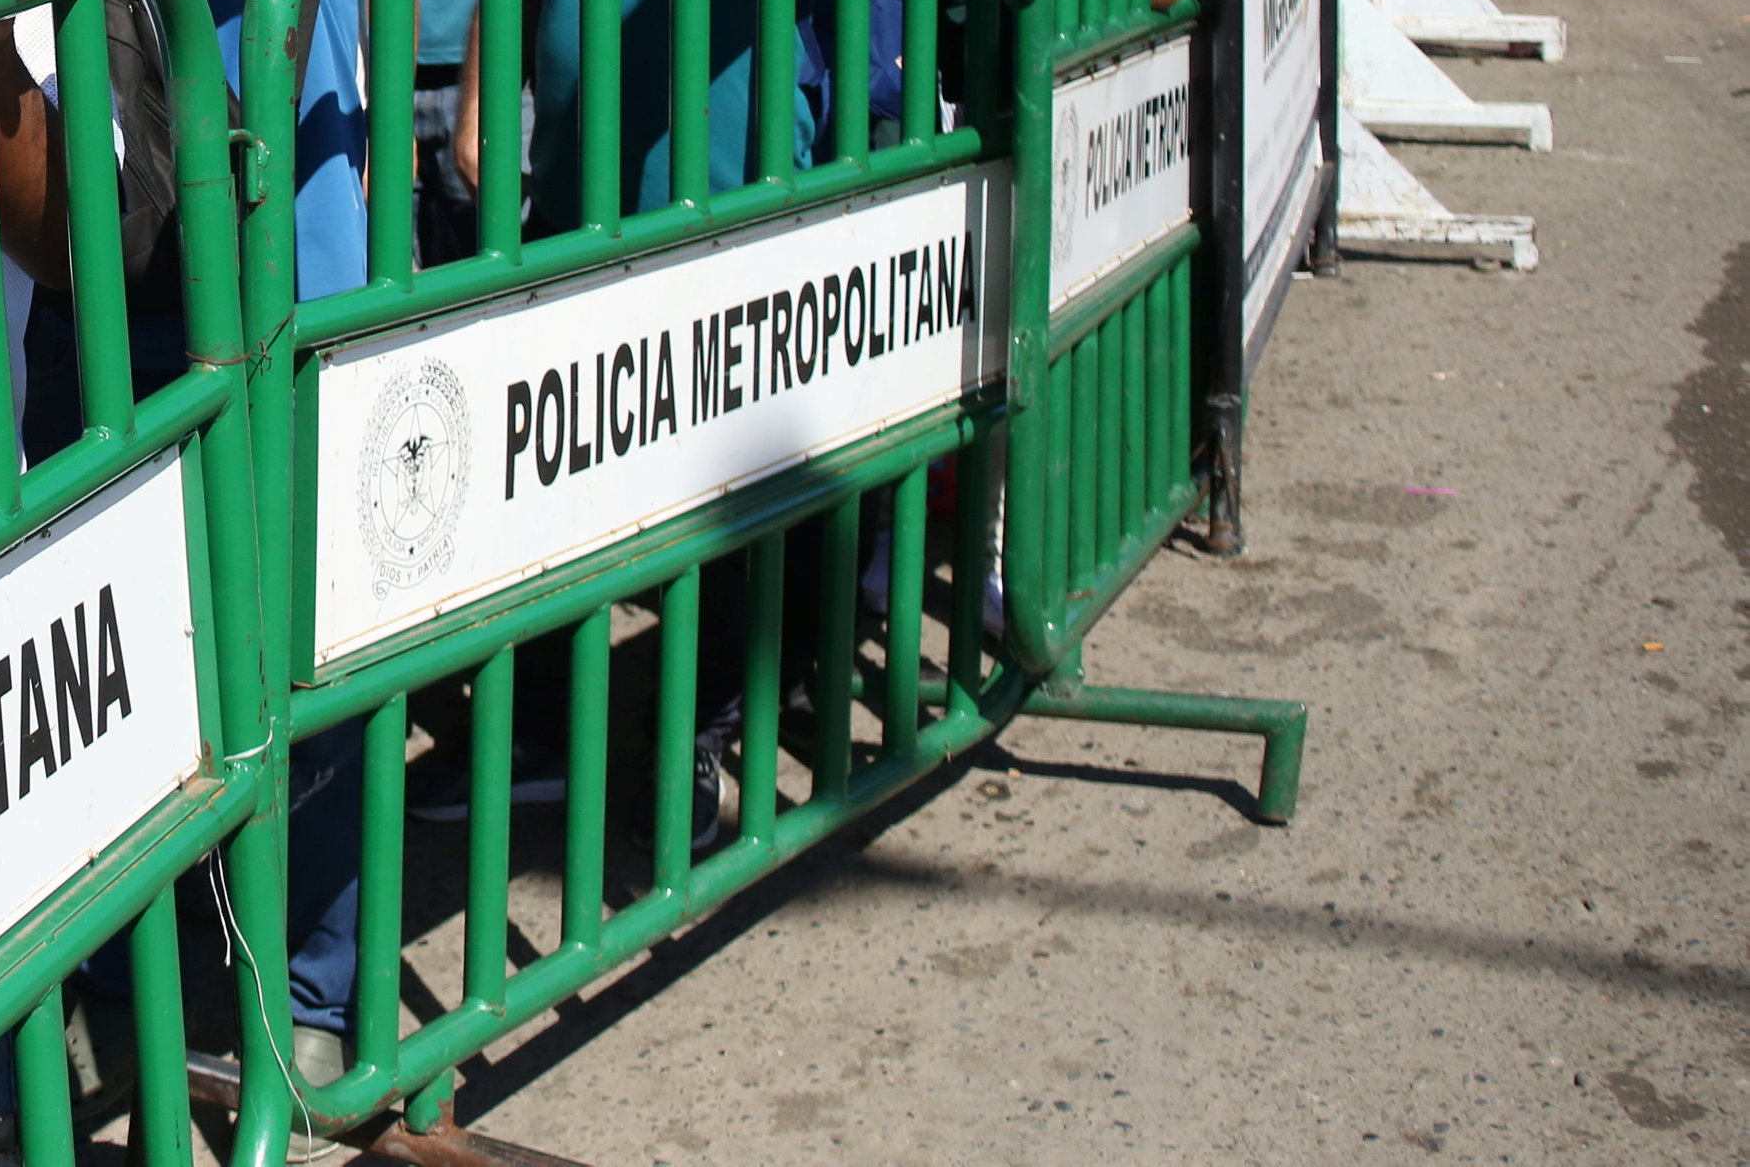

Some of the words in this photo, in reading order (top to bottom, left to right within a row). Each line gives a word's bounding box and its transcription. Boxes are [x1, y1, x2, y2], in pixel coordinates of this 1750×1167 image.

[1084, 108, 1132, 219] POLICIA
[505, 330, 677, 502] POLICIA
[691, 230, 976, 427] METROPOLITANA
[379, 563, 401, 583] DIOS
[407, 571, 413, 584] Y
[417, 538, 449, 579] PATRIA
